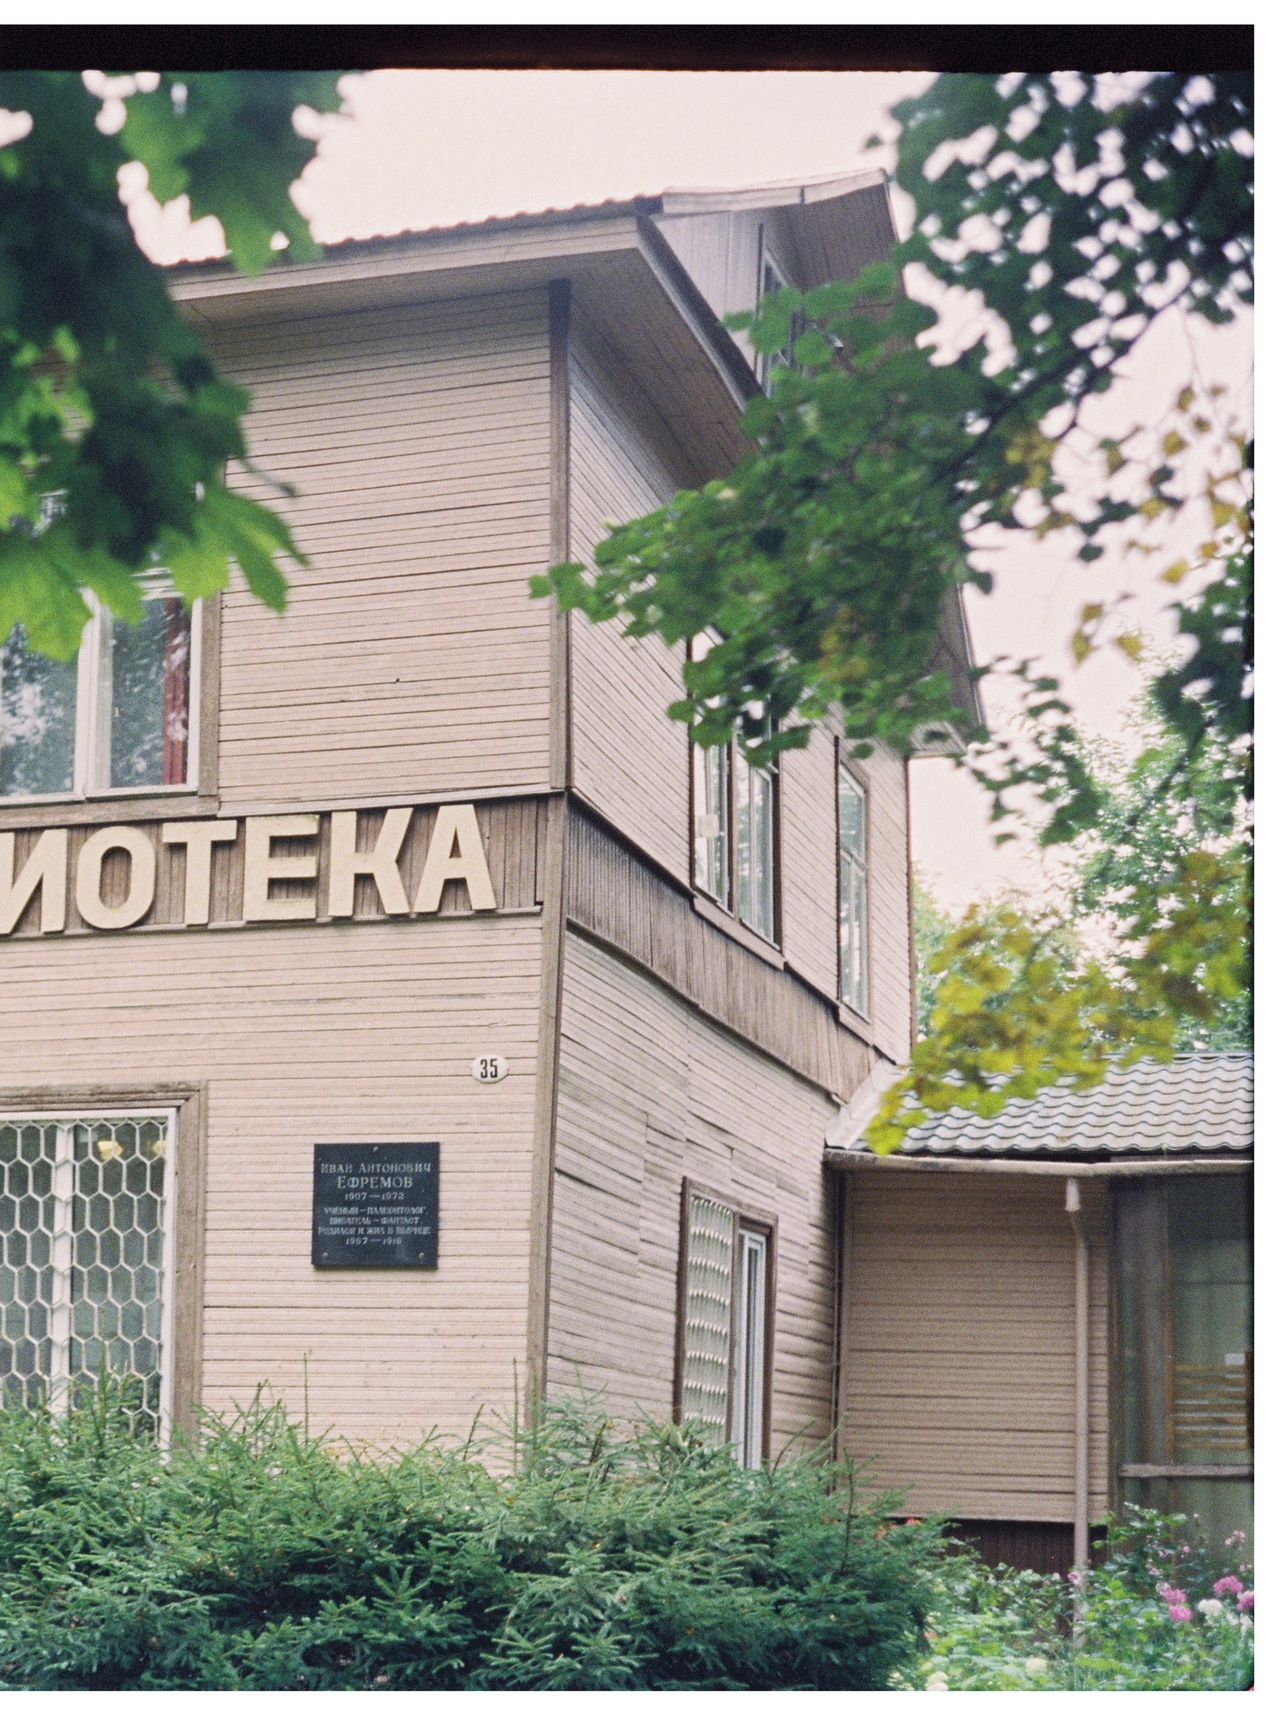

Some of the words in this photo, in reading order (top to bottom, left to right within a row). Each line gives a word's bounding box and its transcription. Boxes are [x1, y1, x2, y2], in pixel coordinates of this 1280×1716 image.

[480, 1058, 498, 1079] 35
[321, 1163, 353, 1174] ИВАН
[337, 1176, 413, 1189] ЕФРЕМОВ
[358, 1226, 364, 1235] И
[367, 1226, 385, 1235] ЖИЛ
[387, 1226, 393, 1235] В
